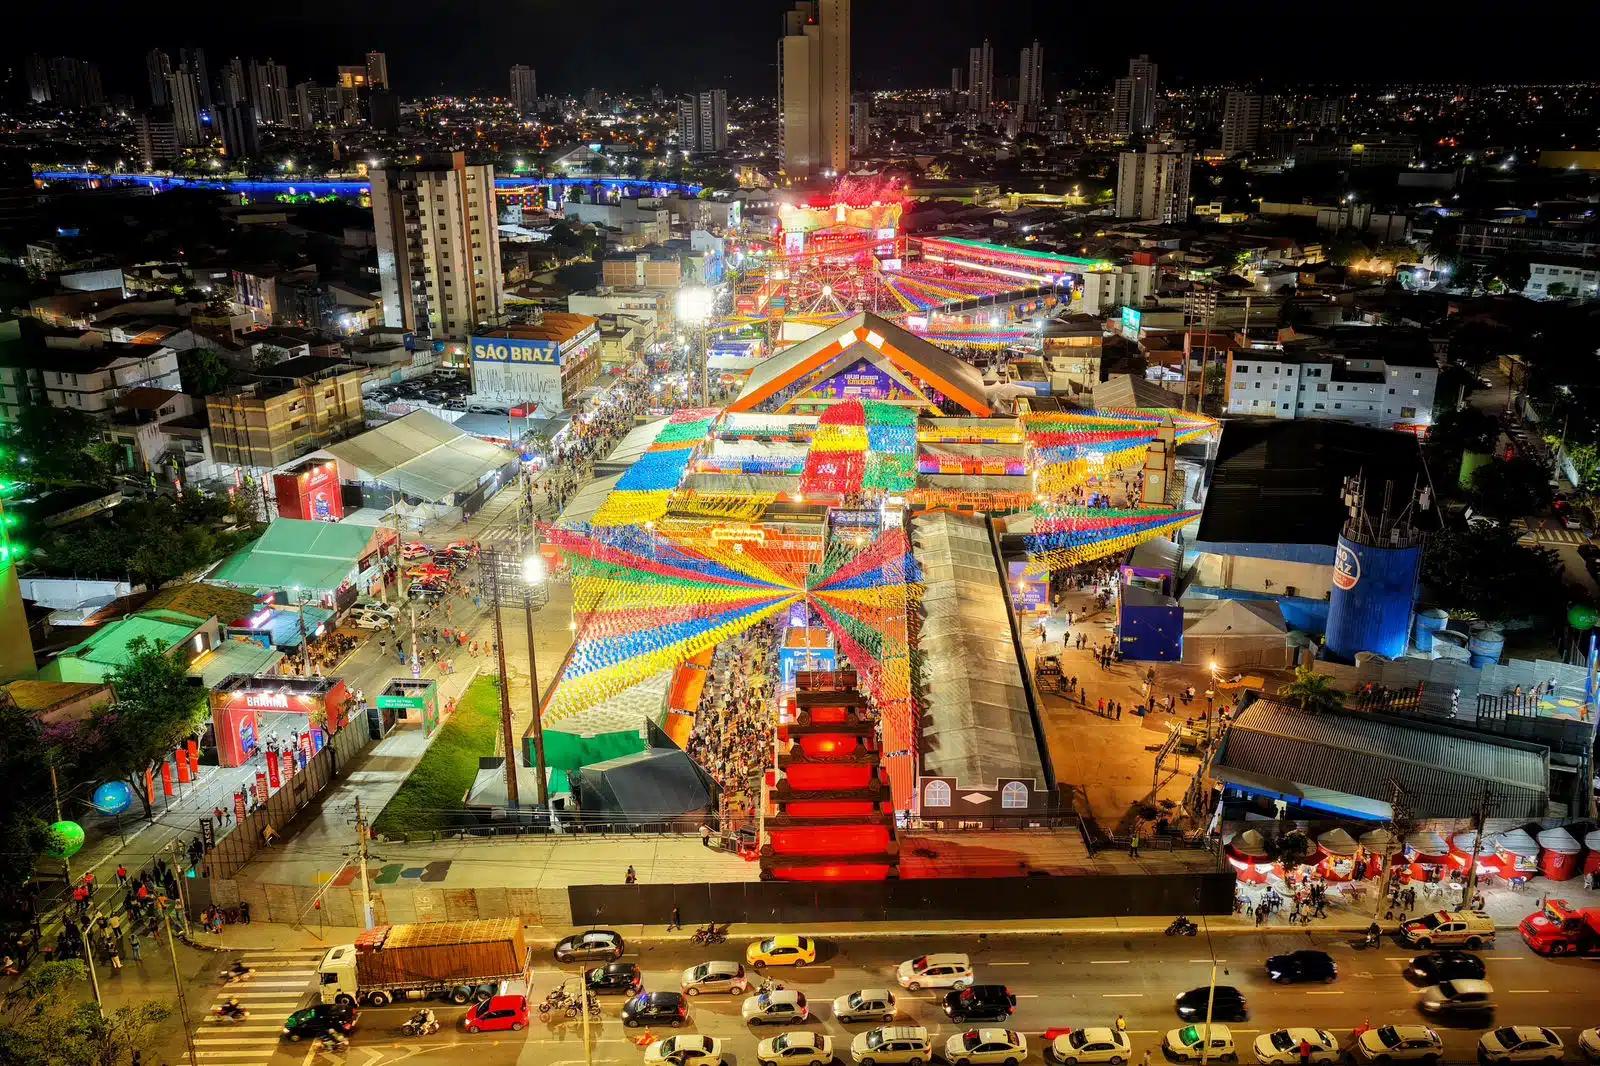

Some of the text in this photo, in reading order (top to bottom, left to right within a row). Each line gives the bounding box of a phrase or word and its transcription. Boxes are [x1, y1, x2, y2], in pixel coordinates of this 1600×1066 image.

[475, 343, 554, 362] SÃO BRAZ
[247, 695, 288, 708] BRAHMA
